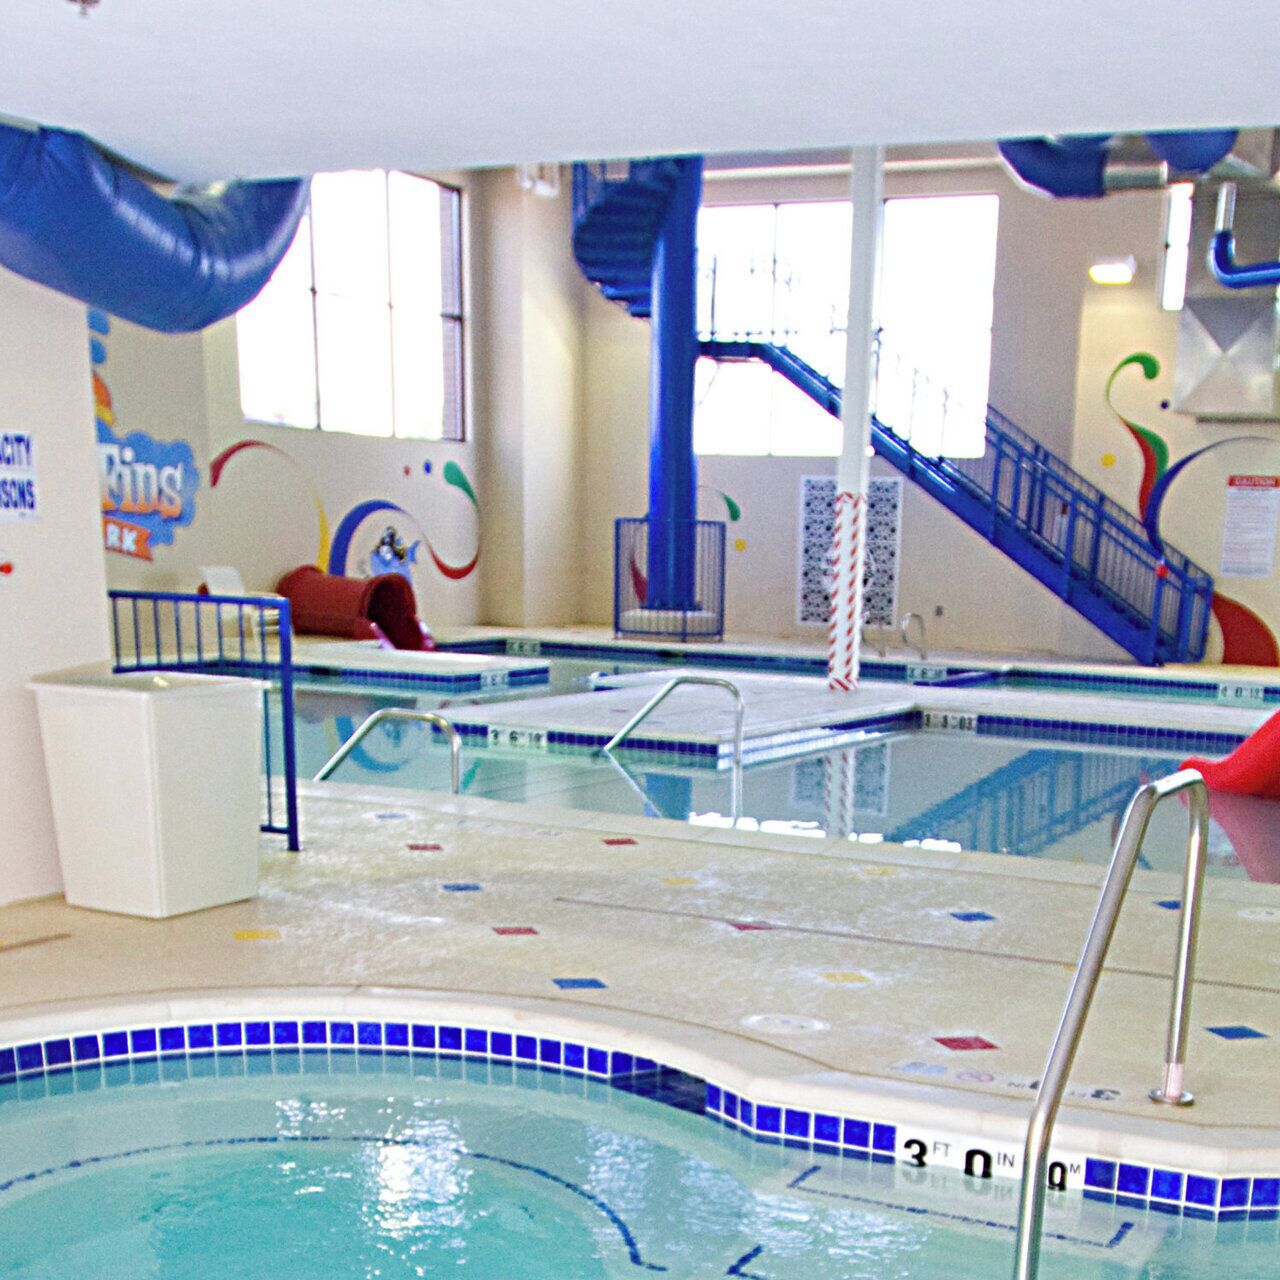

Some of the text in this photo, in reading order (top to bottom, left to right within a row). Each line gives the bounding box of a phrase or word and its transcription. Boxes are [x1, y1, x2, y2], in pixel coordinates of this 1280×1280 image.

[100, 444, 184, 518] Fins
[106, 524, 137, 552] RK
[903, 1138, 928, 1168] 3
[932, 1141, 952, 1157] FT
[964, 1148, 993, 1179] 0
[997, 1152, 1015, 1169] IN
[1048, 1161, 1068, 1192] 0
